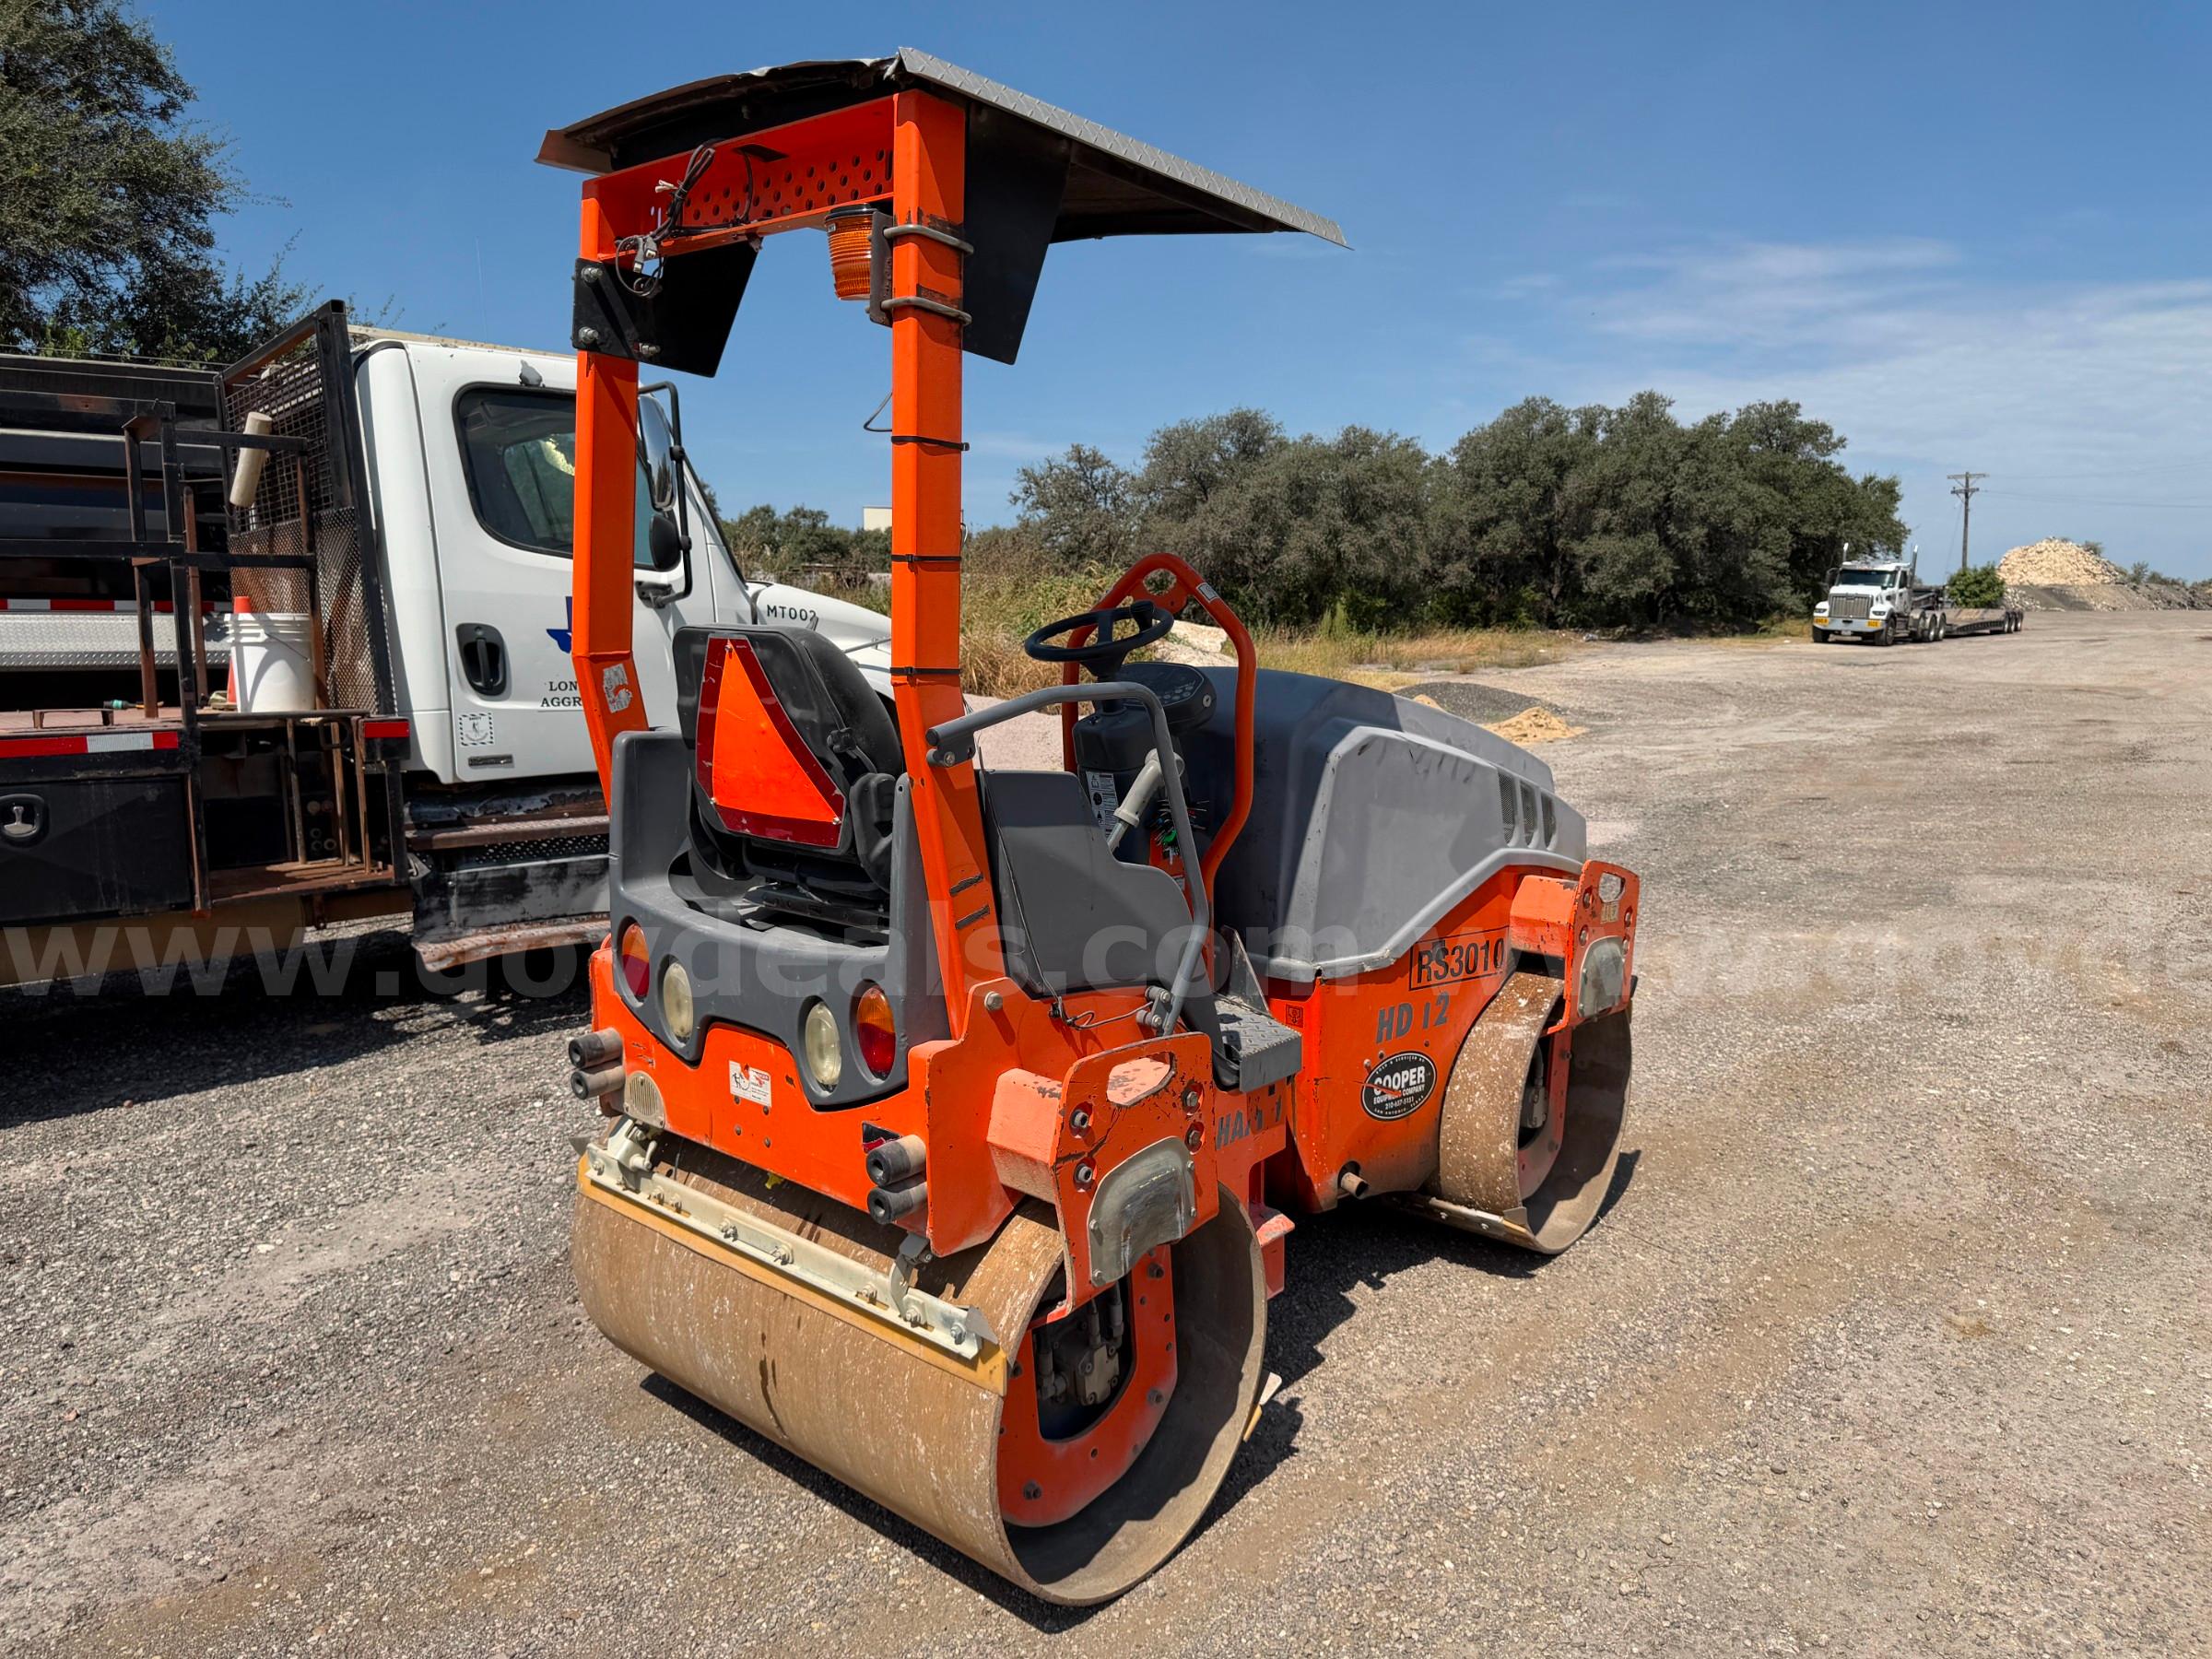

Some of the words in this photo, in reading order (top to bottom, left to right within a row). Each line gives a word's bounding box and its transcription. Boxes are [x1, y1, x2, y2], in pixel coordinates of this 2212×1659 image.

[548, 680, 578, 692] LON
[540, 697, 582, 708] AGGR
[1417, 937, 1505, 984] RS3010
[1376, 1002, 1413, 1044] HD
[1423, 991, 1450, 1030] 12
[1373, 1065, 1426, 1096] COOPER
[1402, 1084, 1426, 1097] COMPANY
